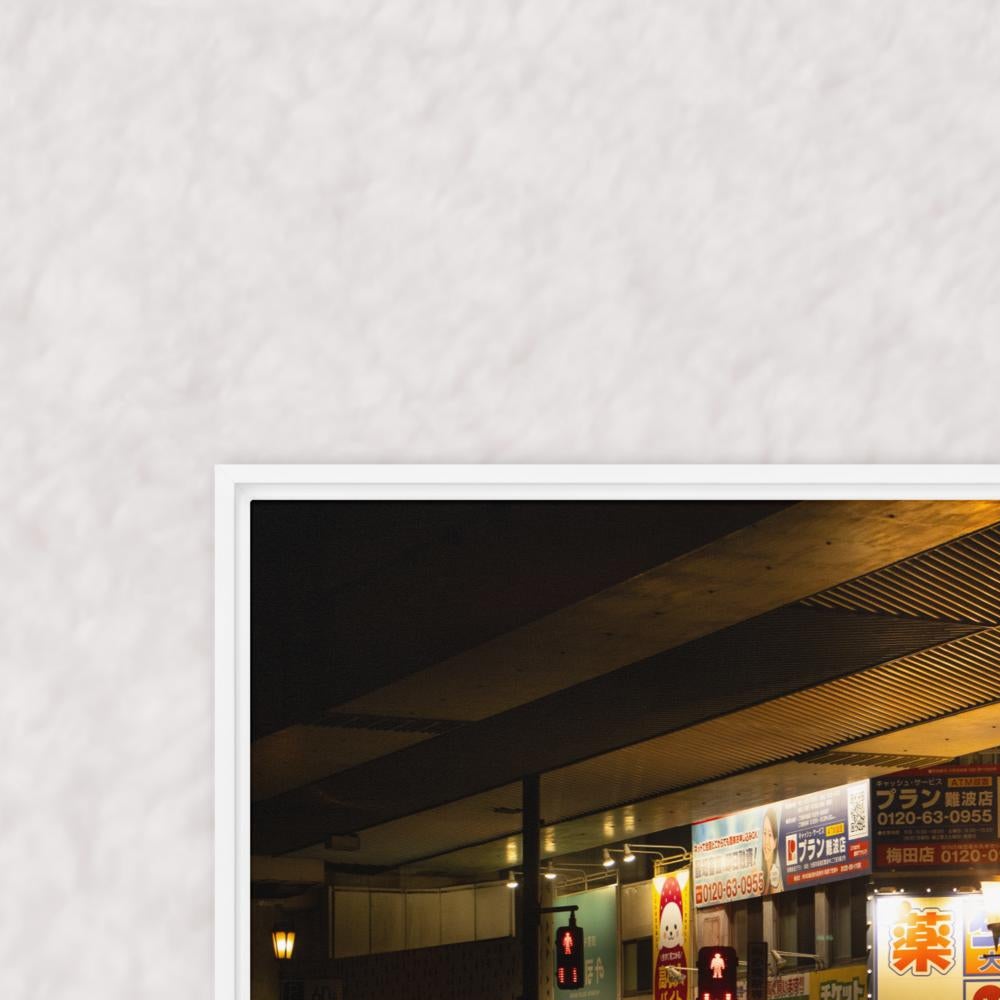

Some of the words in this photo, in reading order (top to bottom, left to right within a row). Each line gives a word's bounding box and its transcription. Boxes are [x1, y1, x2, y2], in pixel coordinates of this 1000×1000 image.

[876, 788, 941, 810] プラン
[877, 809, 993, 826] 0120-63-0955
[798, 838, 825, 863] プラン
[886, 847, 934, 864] 梅田店
[703, 873, 764, 903] 0120-63-0955
[891, 909, 953, 973] 薬
